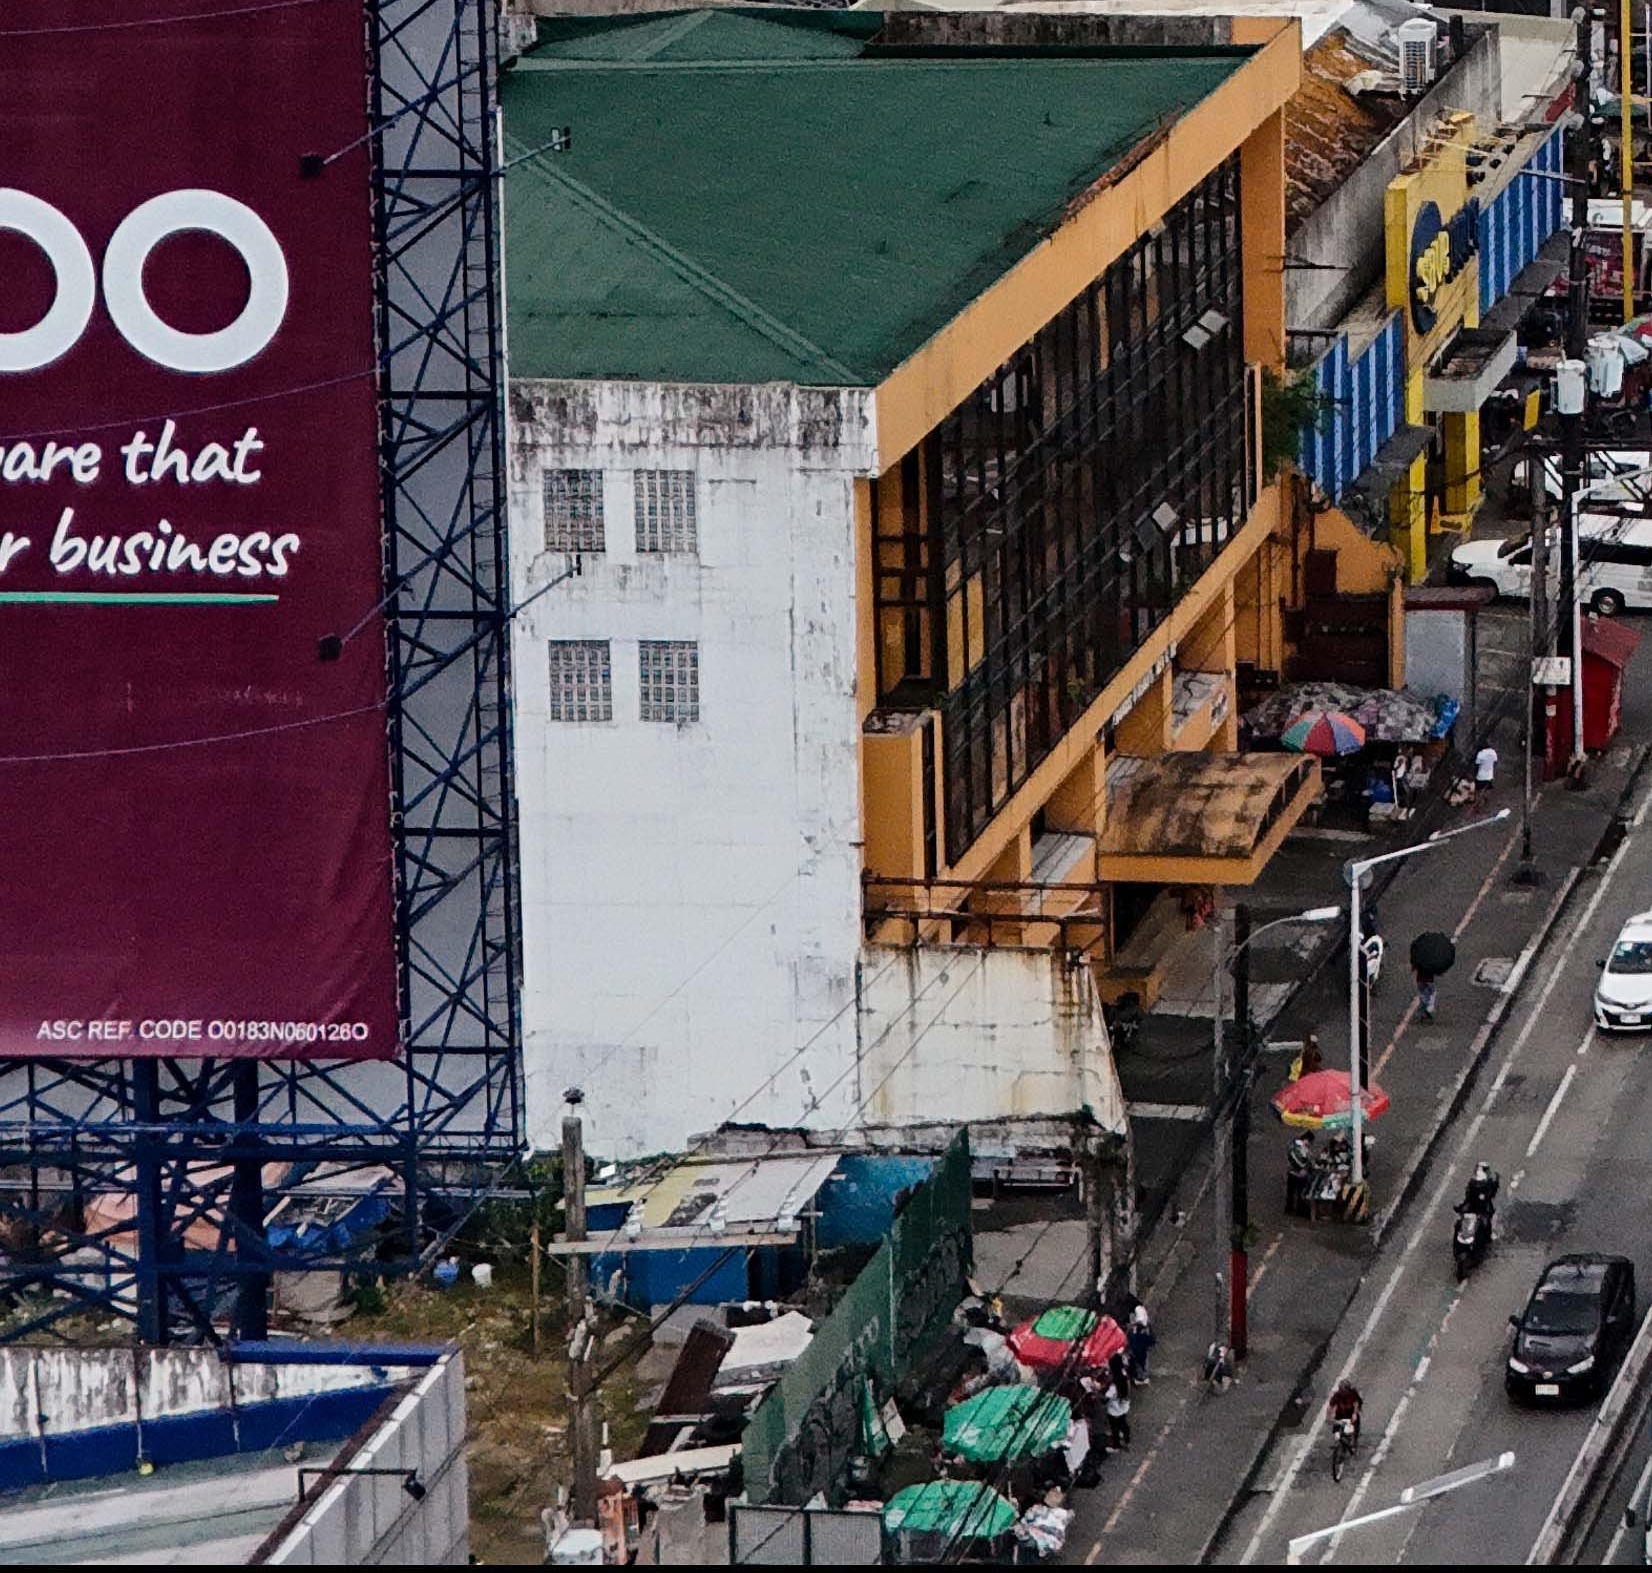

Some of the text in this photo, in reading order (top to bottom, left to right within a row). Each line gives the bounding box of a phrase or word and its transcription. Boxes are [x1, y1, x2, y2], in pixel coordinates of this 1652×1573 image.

[0, 419, 264, 484] are that
[50, 507, 300, 576] business
[36, 1020, 83, 1041] ASC
[138, 1020, 202, 1041] CODE
